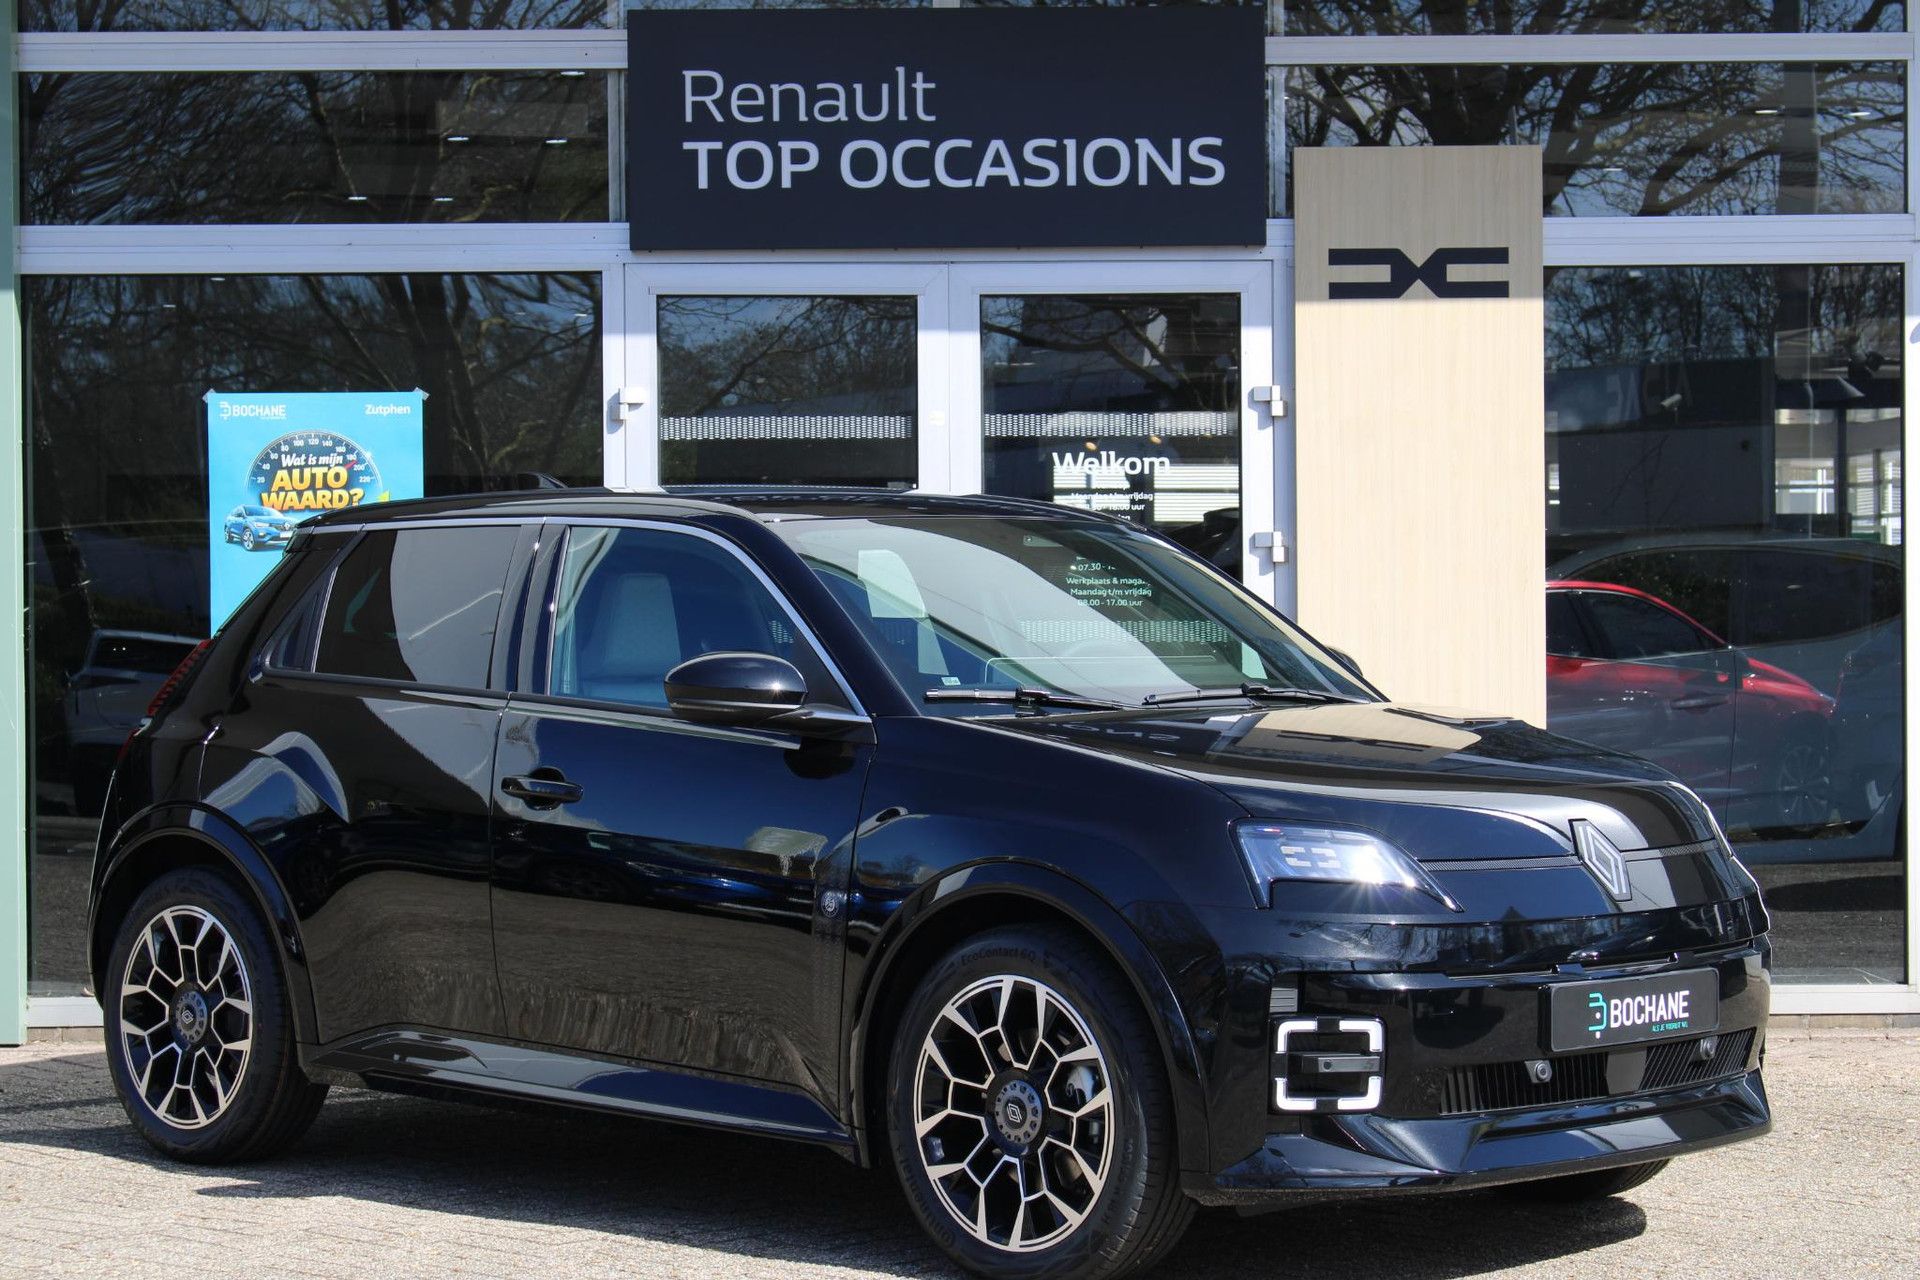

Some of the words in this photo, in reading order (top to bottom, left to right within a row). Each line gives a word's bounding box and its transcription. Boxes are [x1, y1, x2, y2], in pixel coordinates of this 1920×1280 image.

[682, 66, 936, 123] Renault
[682, 140, 820, 190] TOP
[840, 136, 1226, 189] OCCASIONS
[232, 404, 286, 416] BOCHANE
[365, 403, 411, 416] Zutphen
[281, 453, 306, 468] Wat
[308, 453, 317, 465] is
[319, 453, 343, 467] mijn
[1051, 451, 1170, 475] Welkom
[271, 466, 348, 492] AUTO
[261, 488, 365, 510] WAARD?
[1125, 492, 1153, 501] vrijdag
[1131, 503, 1145, 511] uur
[1078, 562, 1101, 571] 07.30
[1065, 577, 1110, 586] Werkplaats
[1070, 588, 1107, 597] Maandag
[1108, 588, 1123, 596] t/m
[1124, 588, 1152, 597] vrijdag
[1610, 990, 1690, 1028] BOCHANE
